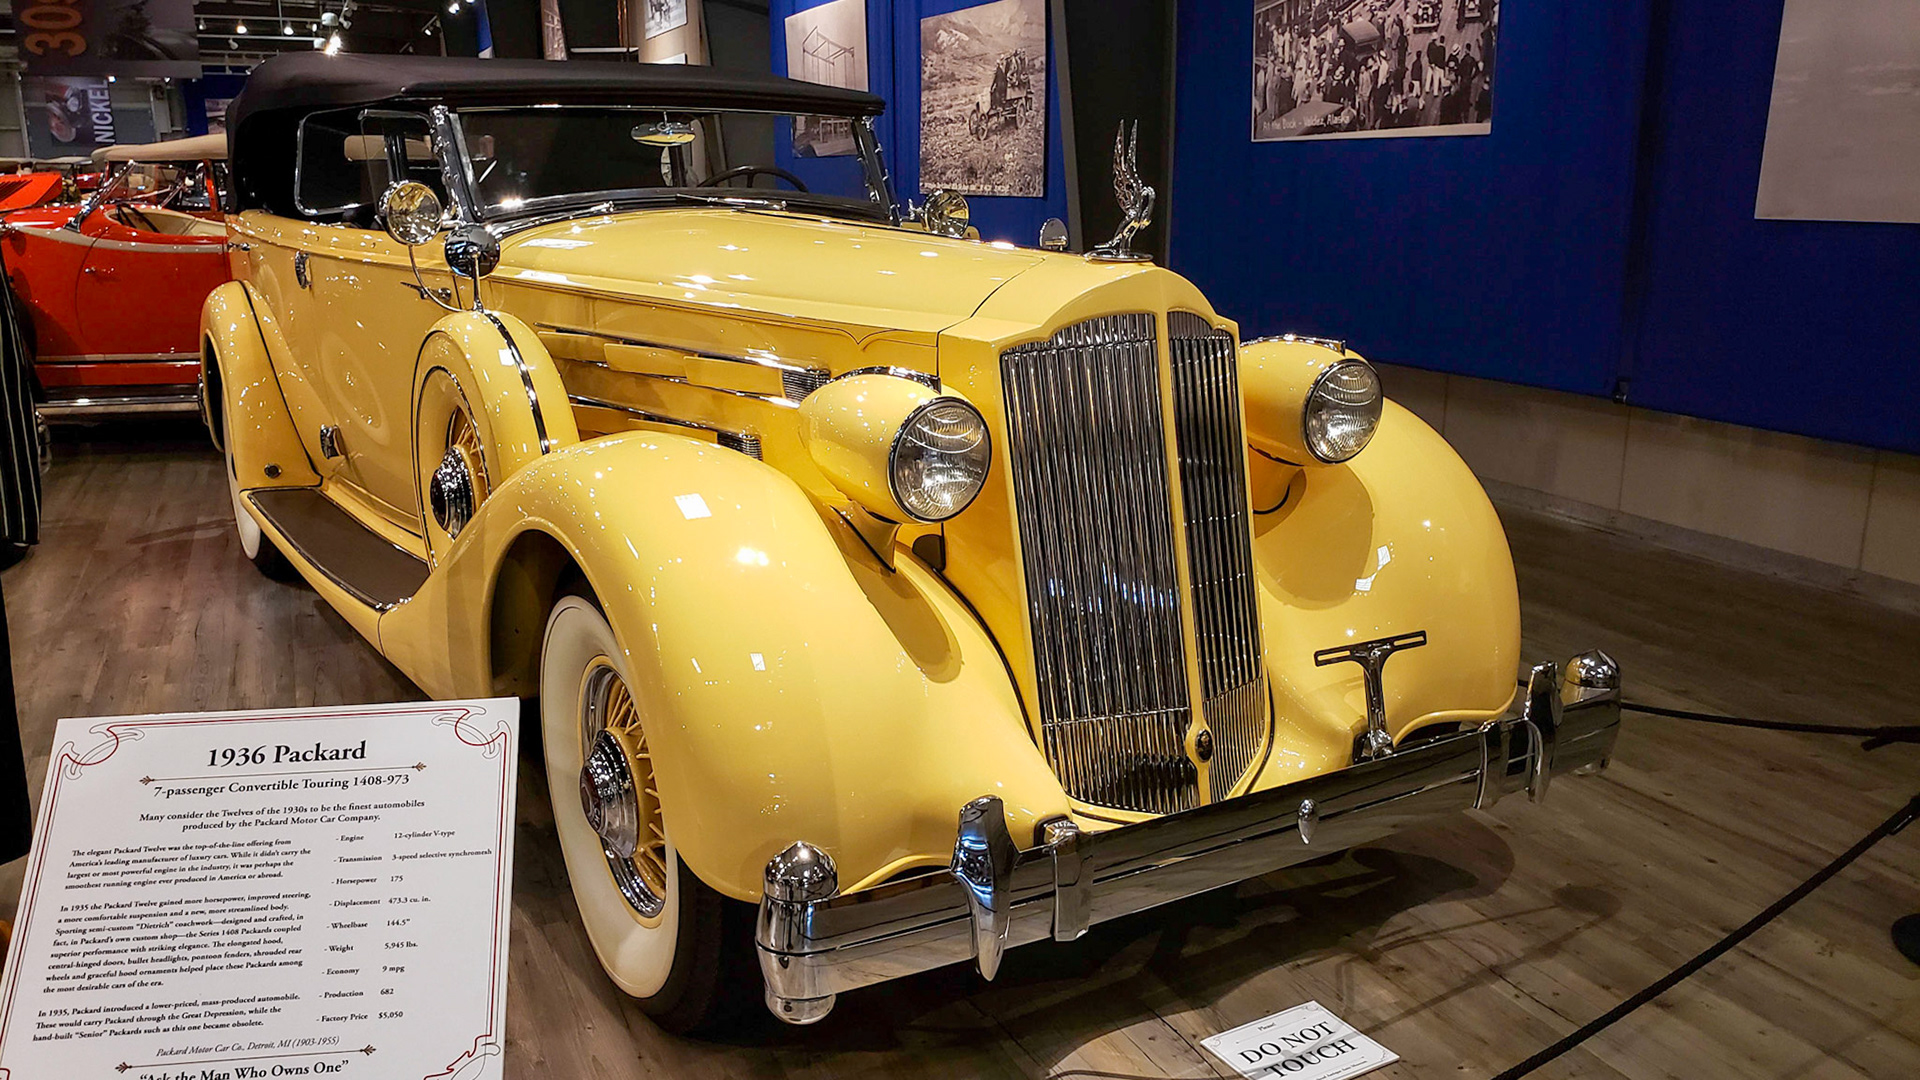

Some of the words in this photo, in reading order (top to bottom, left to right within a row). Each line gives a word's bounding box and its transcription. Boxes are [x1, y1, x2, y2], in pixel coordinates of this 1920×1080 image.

[88, 79, 116, 143] NICKEL
[1327, 114, 1350, 125] Alaska
[208, 745, 267, 768] 1936
[273, 740, 366, 764] Packard
[154, 786, 226, 799] 7-passenger
[228, 779, 299, 793] Convertible
[301, 778, 350, 791] Touring
[353, 774, 409, 786] 1408-973
[139, 813, 166, 823] Many
[167, 811, 204, 820] consider
[206, 810, 220, 818] the
[221, 809, 254, 817] Twelves
[255, 807, 267, 816] of
[267, 807, 281, 815] the
[283, 806, 308, 814] 1930s
[321, 804, 331, 812] be
[333, 803, 347, 812] the
[348, 802, 372, 811] finest
[373, 799, 425, 809] automobiles
[182, 820, 224, 833] produced
[226, 820, 237, 830] by
[238, 819, 253, 827] the
[254, 817, 289, 827] Packard
[290, 816, 318, 825] Motor
[320, 815, 336, 823] Car
[337, 814, 381, 824] Company.
[340, 835, 364, 843] Engine
[395, 831, 433, 840] 12-cylinder
[433, 830, 455, 838] V-type
[87, 849, 112, 857] elegant
[113, 846, 142, 855] Packard
[143, 845, 167, 853] Twelve
[195, 841, 245, 852] top-of-the-line
[246, 839, 274, 848] offering
[338, 855, 383, 863] Transmission
[392, 852, 418, 862] 3-speed
[448, 848, 492, 859] synchromesh
[104, 858, 131, 867] leading
[131, 856, 179, 864] manufacturer
[180, 854, 189, 862] of
[189, 854, 212, 862] luxury
[65, 882, 102, 890] smoothest
[103, 880, 132, 888] running
[133, 879, 157, 887] engine
[174, 875, 208, 885] produced
[217, 873, 247, 881] America
[257, 871, 283, 879] abroad.
[336, 878, 377, 886] Horsepower
[71, 904, 89, 912] 1935
[104, 901, 133, 910] Packard
[134, 900, 158, 908] Twelve
[158, 898, 183, 908] gained
[248, 893, 281, 902] improved
[282, 892, 311, 900] steering.
[334, 899, 381, 908] Displacement
[331, 921, 368, 929] Wheelbase
[329, 944, 354, 954] Weight
[385, 941, 405, 950] 5,945
[382, 965, 388, 973] 9
[43, 986, 55, 994] the
[76, 983, 110, 991] desirable
[127, 980, 137, 988] of
[324, 990, 364, 999] Production
[49, 1008, 70, 1017] 1935,
[72, 1006, 102, 1015] Packard
[103, 1003, 144, 1013] introduced
[151, 1000, 200, 1010] lower-priced,
[201, 996, 256, 1007] mass-produced
[257, 993, 300, 1003] automobile.
[58, 1019, 83, 1028] would
[104, 1016, 135, 1025] Packard
[136, 1013, 166, 1024] through
[168, 1013, 180, 1021] the
[181, 1012, 202, 1020] Great
[203, 1009, 247, 1019] Depression,
[248, 1006, 268, 1015] while
[321, 1015, 349, 1023] Factory
[378, 1011, 404, 1019] $5,050
[32, 1032, 73, 1041] hand-built
[109, 1027, 142, 1036] Packards
[144, 1026, 161, 1034] such
[172, 1024, 186, 1032] this
[203, 1022, 231, 1030] became
[232, 1019, 264, 1028] obsolete.
[156, 1046, 189, 1057] Packard
[188, 1046, 214, 1055] Motor
[215, 1044, 231, 1053] Car
[247, 1042, 276, 1051] Detroit,
[277, 1039, 292, 1048] MI
[292, 1036, 340, 1049] (1903-1955)
[1239, 1041, 1282, 1064] DO
[1282, 1021, 1337, 1049] NOT
[1263, 1038, 1358, 1079] TOUCH
[201, 1069, 230, 1080] Man
[234, 1066, 267, 1079] Who
[271, 1064, 310, 1077] Owns
[313, 1060, 349, 1074] One”
